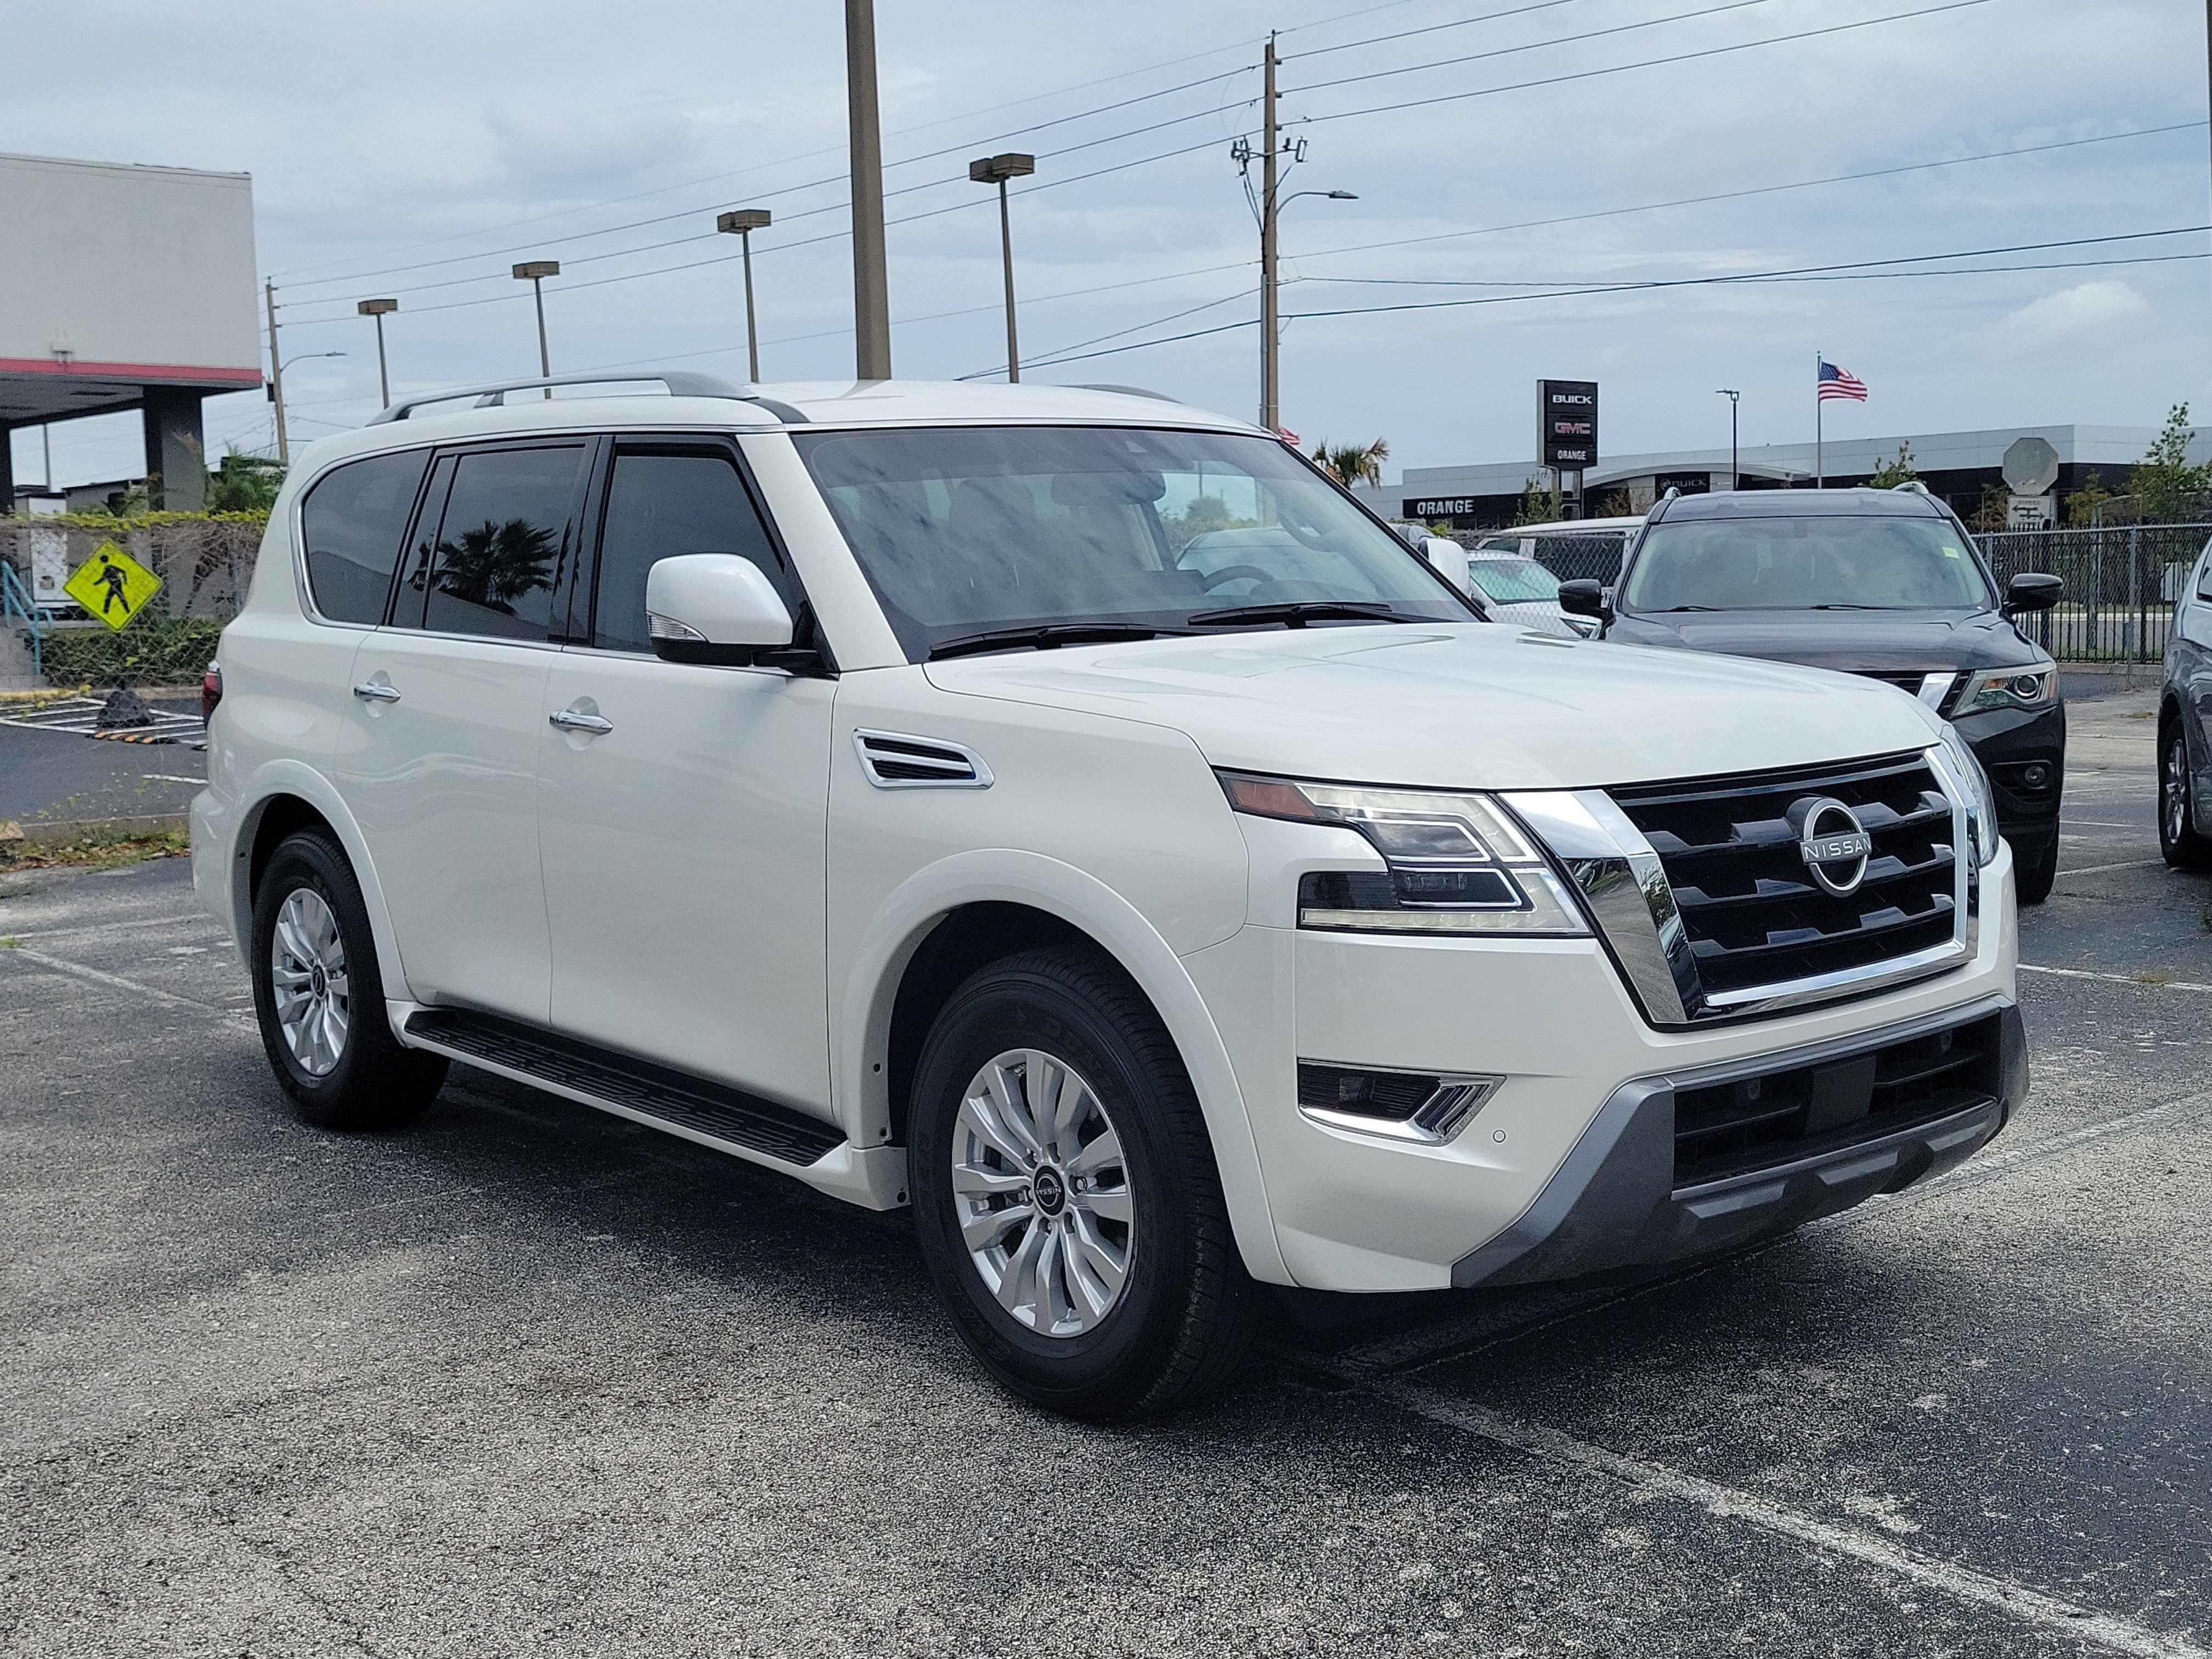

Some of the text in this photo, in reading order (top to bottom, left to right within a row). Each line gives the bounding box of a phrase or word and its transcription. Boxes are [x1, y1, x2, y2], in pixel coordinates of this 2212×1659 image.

[1552, 394, 1593, 404] BUICK
[1555, 422, 1590, 434] GMC
[1557, 450, 1587, 460] ORANGE
[1417, 499, 1474, 515] ORANGE
[1804, 837, 1872, 860] NISSAN
